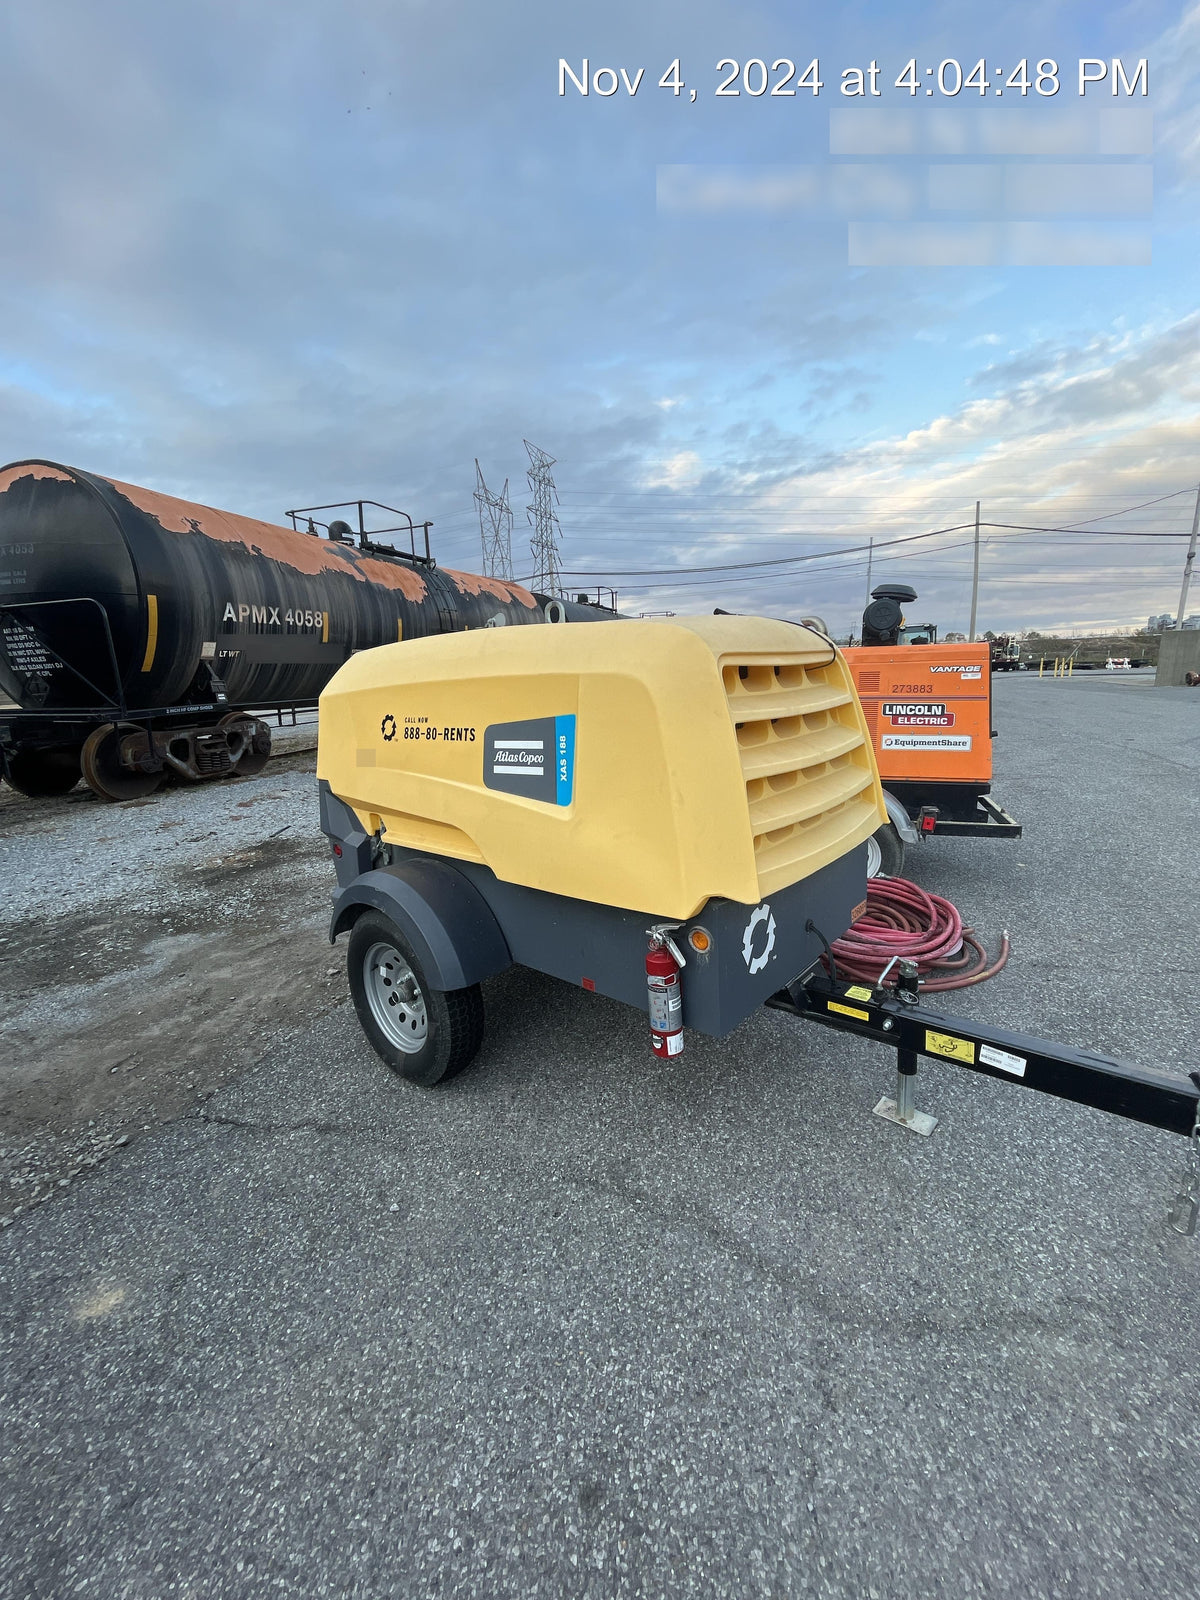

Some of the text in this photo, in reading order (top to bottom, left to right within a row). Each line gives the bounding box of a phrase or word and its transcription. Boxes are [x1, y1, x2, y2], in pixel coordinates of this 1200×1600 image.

[222, 602, 323, 628] APMX 4058
[929, 665, 982, 673] VANTAGE
[892, 685, 933, 693] 273883
[885, 705, 942, 715] LINCOLN
[898, 717, 948, 725] ELECTRIC
[404, 727, 475, 741] 888-80-RENTS
[894, 738, 967, 747] EquipmentShare
